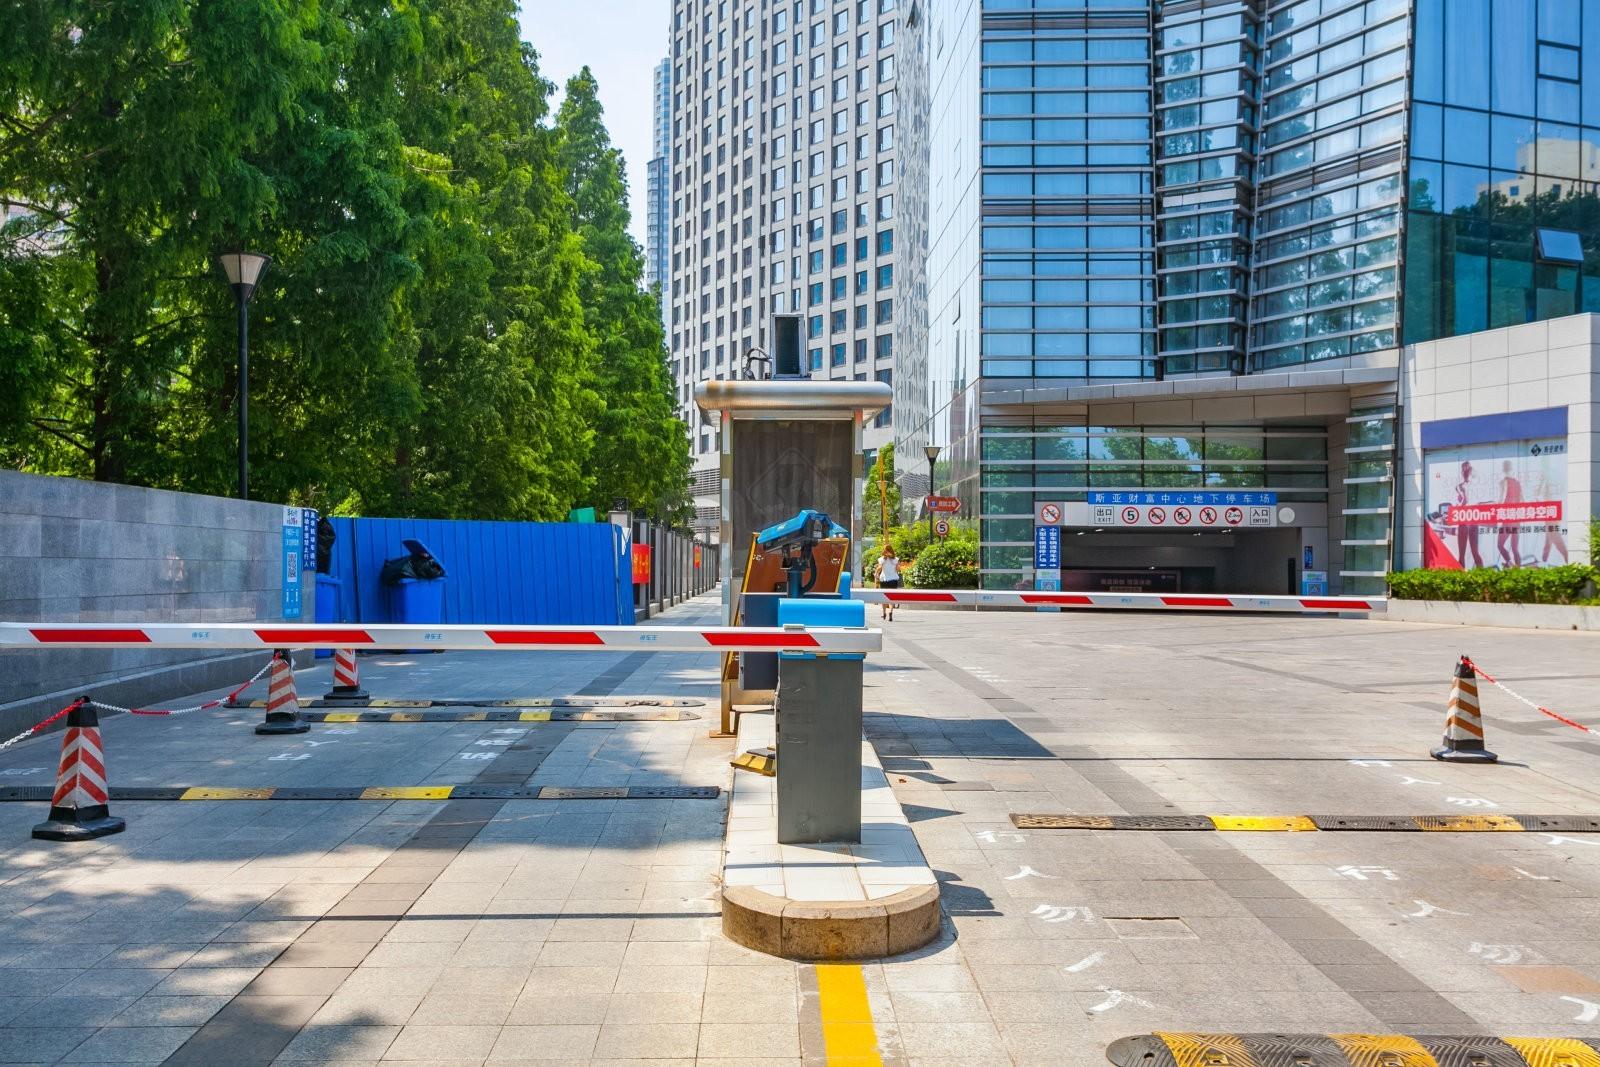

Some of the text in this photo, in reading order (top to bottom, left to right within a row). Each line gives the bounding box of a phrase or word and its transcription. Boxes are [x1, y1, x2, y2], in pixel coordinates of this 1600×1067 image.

[1095, 493, 1270, 504] 斯亚财富中心地下停车场
[1096, 508, 1112, 516] 出口
[1127, 510, 1135, 521] 5
[1252, 509, 1268, 517] 入口
